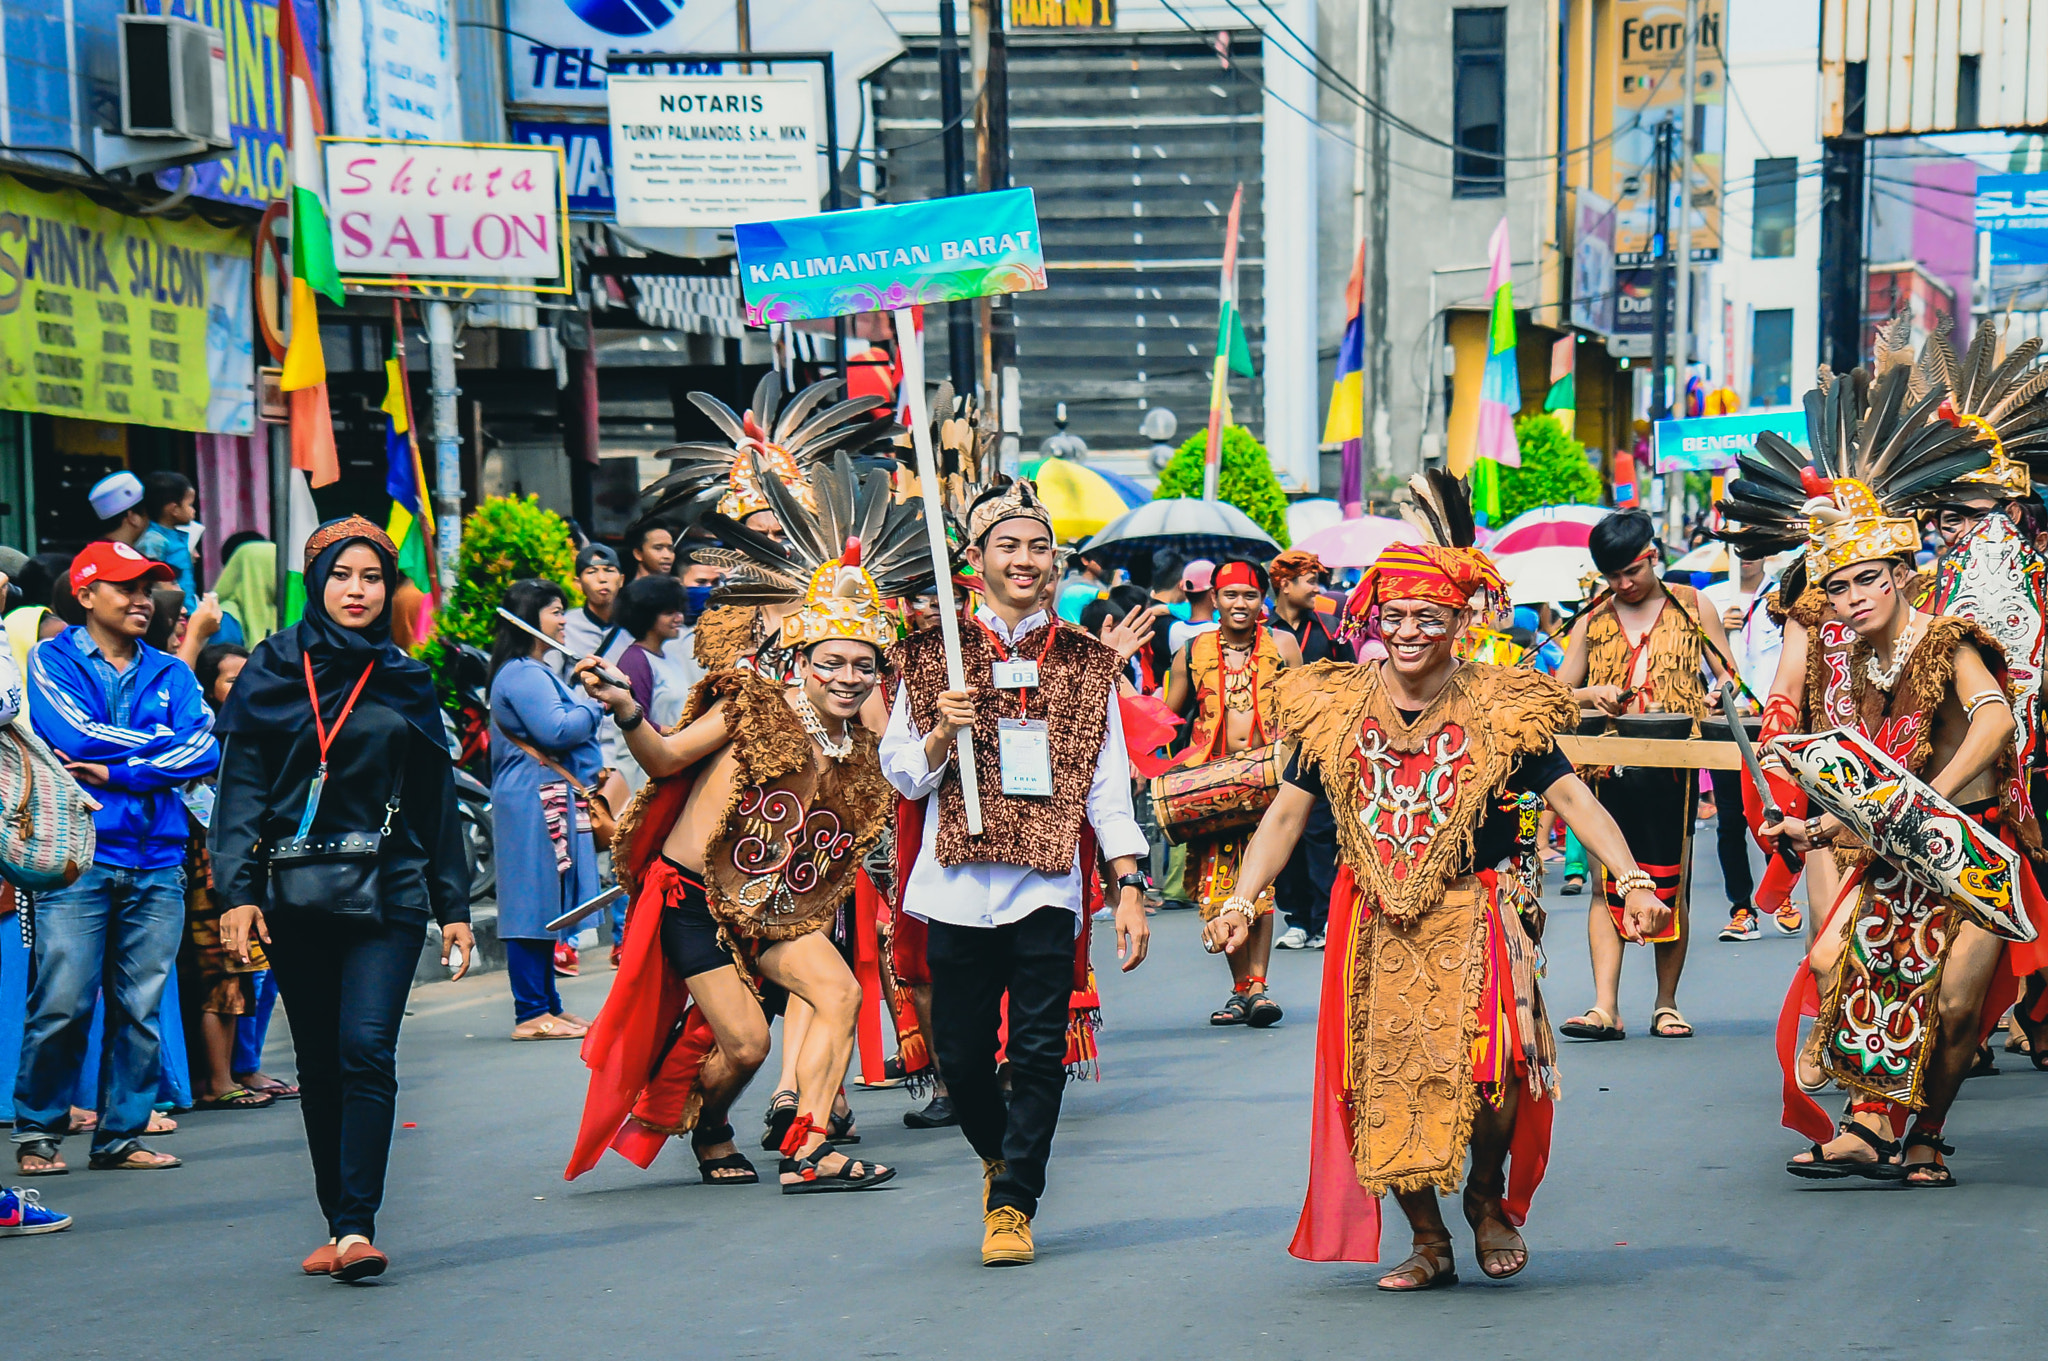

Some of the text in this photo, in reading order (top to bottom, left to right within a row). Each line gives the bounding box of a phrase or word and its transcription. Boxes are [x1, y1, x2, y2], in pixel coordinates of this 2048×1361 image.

[660, 94, 764, 113] NOTARIS
[621, 124, 662, 141] TURNY
[219, 136, 289, 200] SALO
[340, 157, 536, 198] Shinta
[528, 133, 614, 197] WA
[340, 211, 548, 260] SALON
[750, 230, 1032, 283] KALIMANTAN BARAT
[126, 235, 204, 309] SALON
[1682, 431, 1793, 451] BENGK
[1012, 672, 1034, 682] 03
